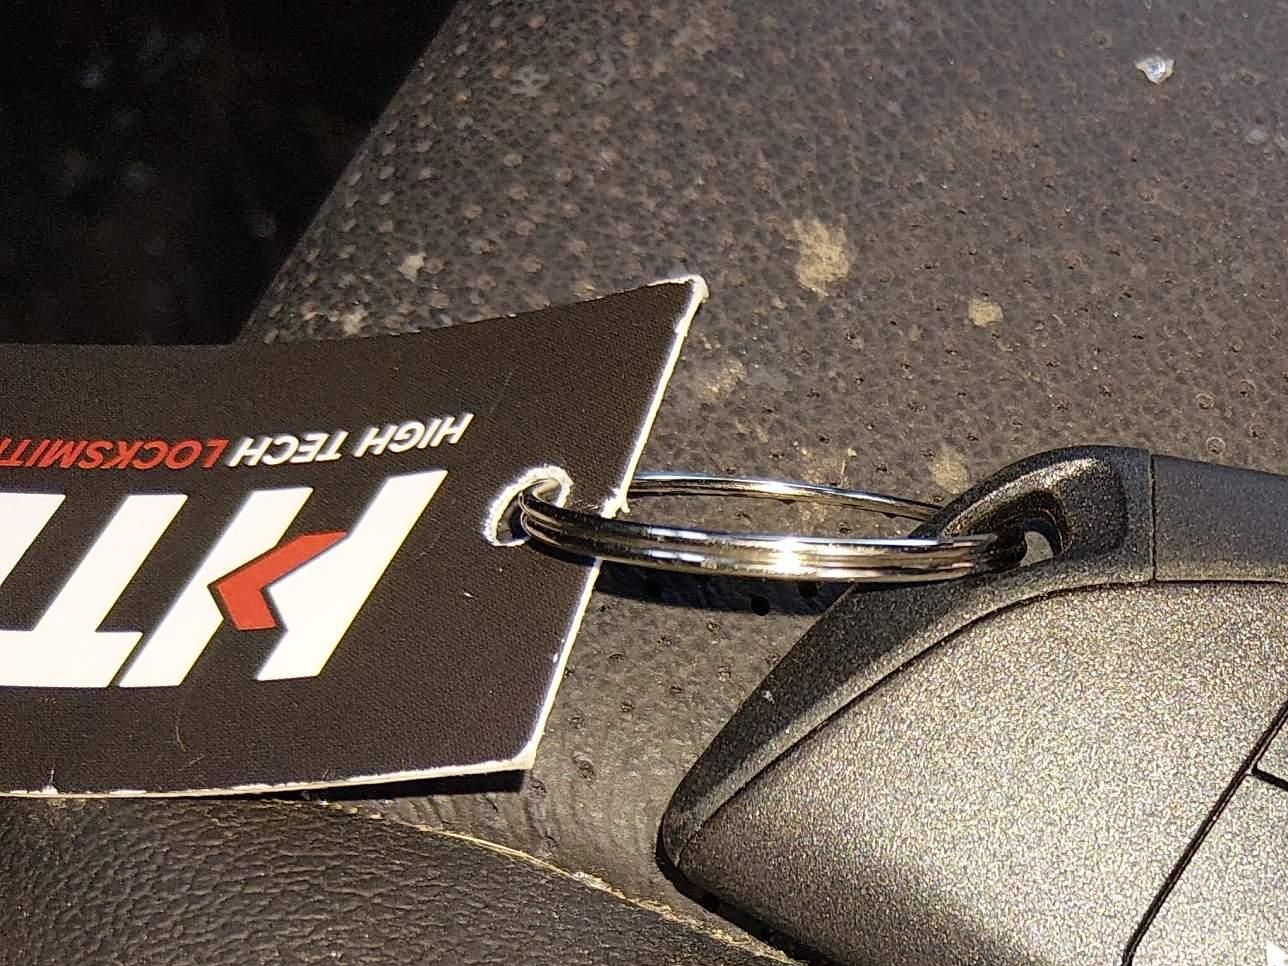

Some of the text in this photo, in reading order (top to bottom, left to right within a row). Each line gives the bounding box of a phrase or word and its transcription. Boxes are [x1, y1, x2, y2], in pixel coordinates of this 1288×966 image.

[0, 413, 474, 470] HIGH TECH LOCKSMIT
